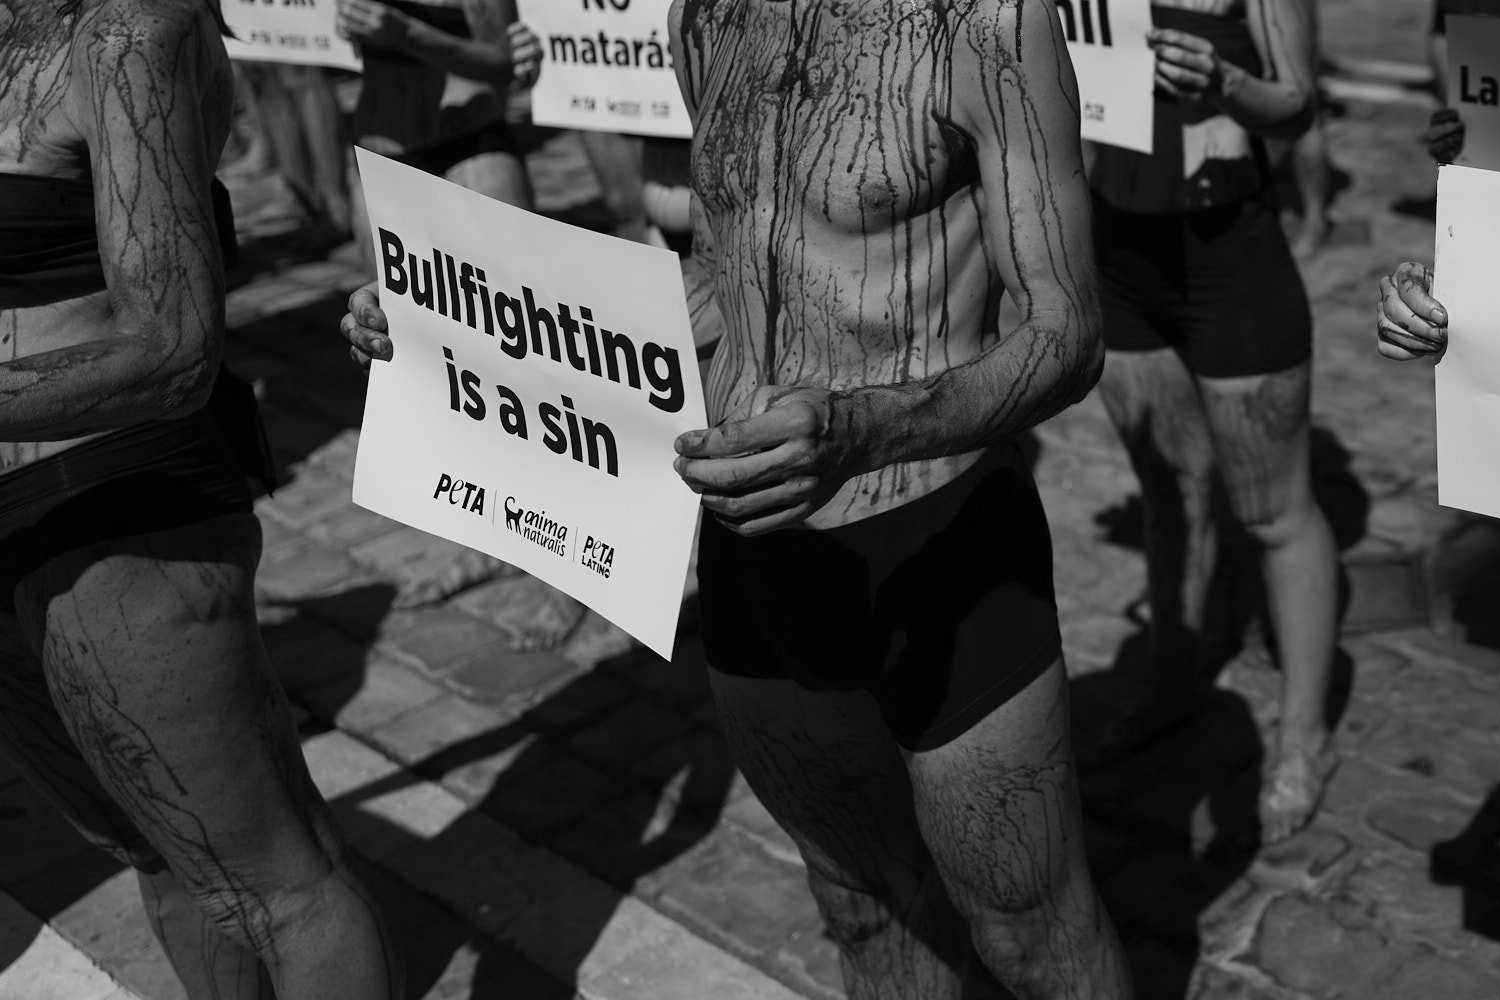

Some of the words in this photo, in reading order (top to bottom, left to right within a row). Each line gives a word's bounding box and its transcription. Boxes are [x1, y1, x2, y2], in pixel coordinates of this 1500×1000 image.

[1459, 65, 1499, 107] La
[378, 227, 685, 413] Bullfighting
[442, 346, 486, 421] is
[496, 384, 529, 441] a
[539, 394, 619, 478] sin
[523, 525, 566, 558] naturalis
[524, 507, 568, 542] anima
